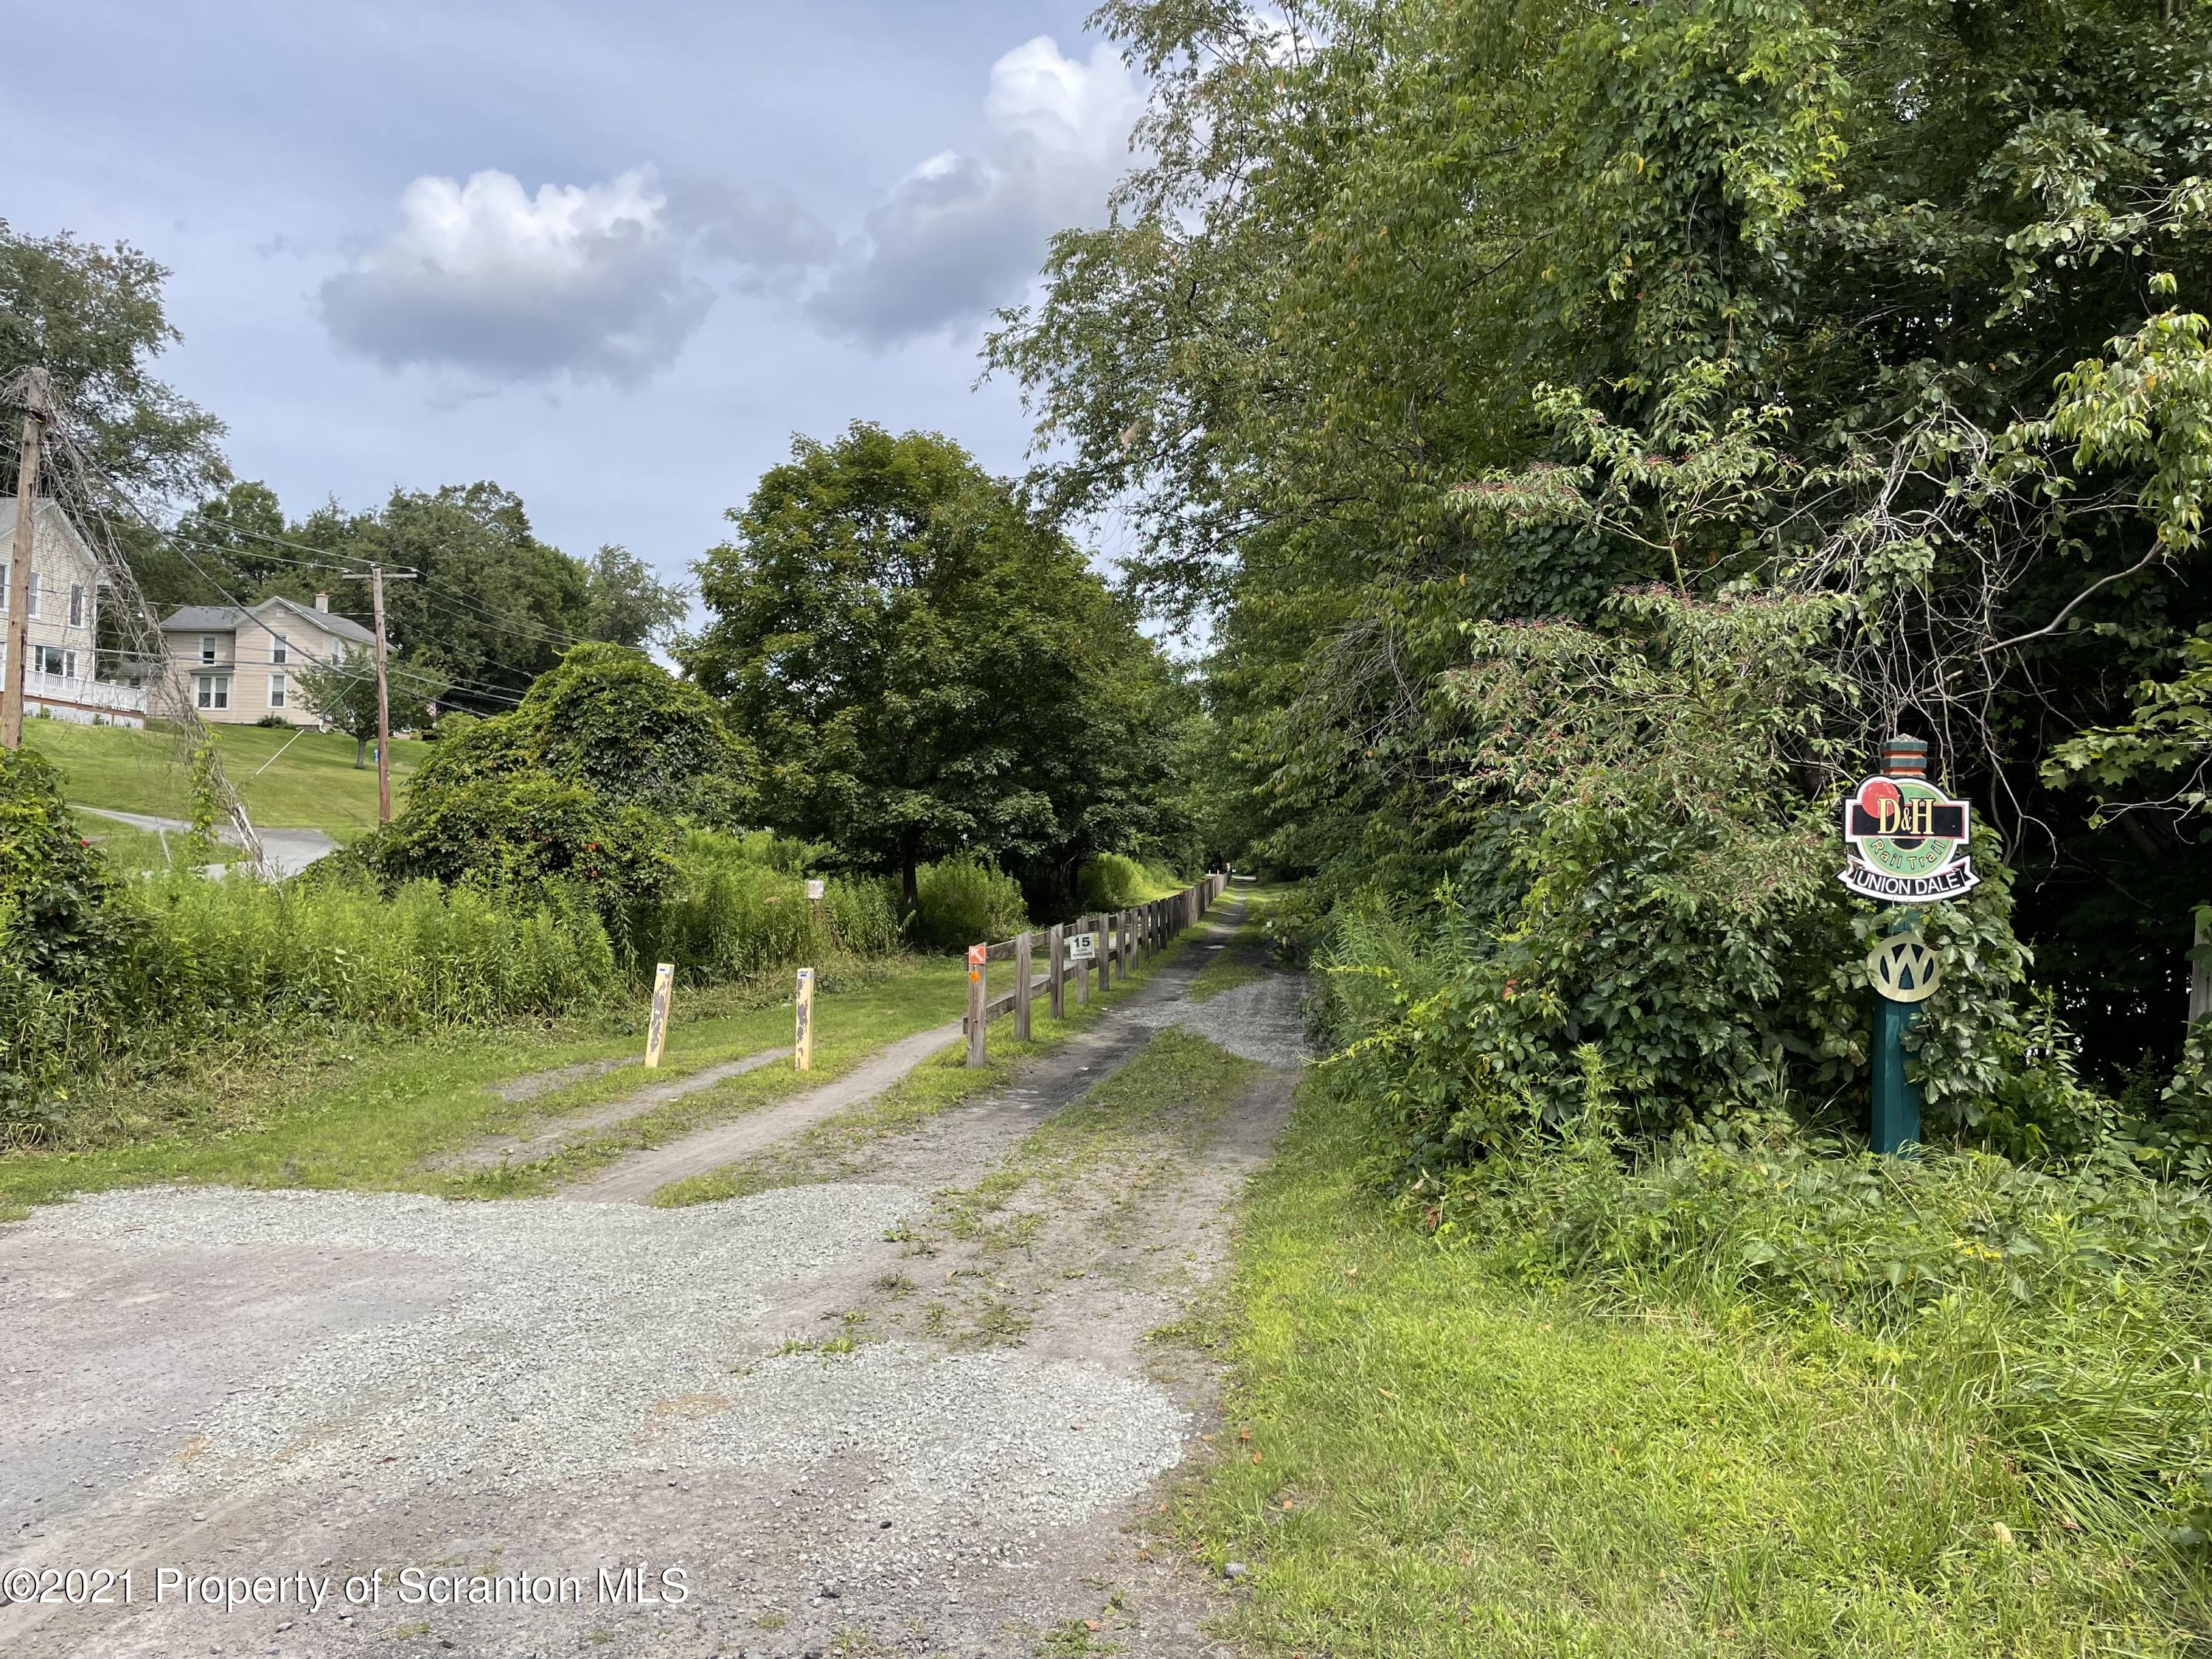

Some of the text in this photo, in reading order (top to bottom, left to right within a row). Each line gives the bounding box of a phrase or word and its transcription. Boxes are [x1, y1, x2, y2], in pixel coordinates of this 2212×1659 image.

[1877, 797, 1935, 835] D&H
[1871, 839, 1947, 870] Rail Trail
[1857, 870, 1961, 895] UNION DALE
[1074, 936, 1091, 948] 15
